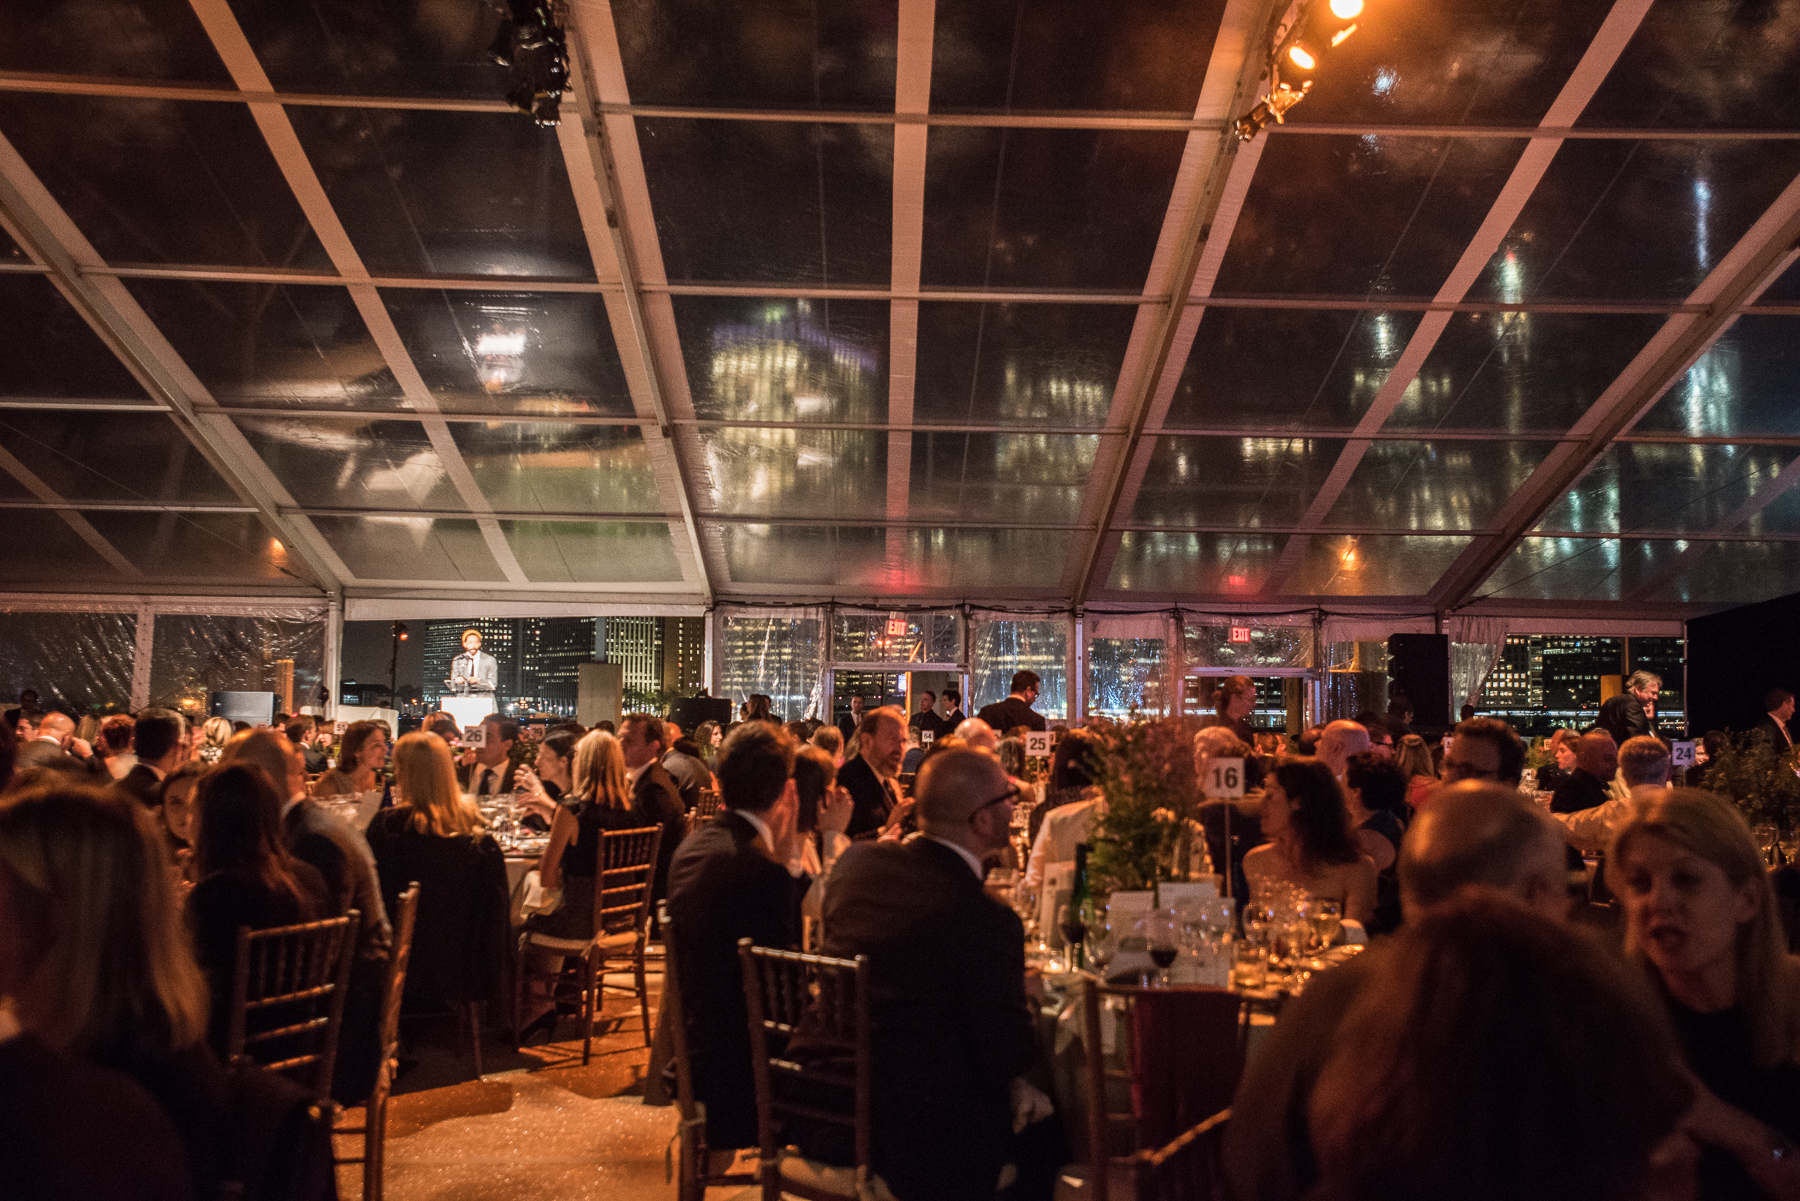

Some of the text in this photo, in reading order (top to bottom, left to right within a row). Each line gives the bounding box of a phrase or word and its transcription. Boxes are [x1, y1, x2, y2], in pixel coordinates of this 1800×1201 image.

[888, 620, 907, 636] EXIT
[1232, 627, 1250, 642] EXIT
[466, 729, 482, 742] 26
[1030, 738, 1046, 750] 25
[1675, 747, 1692, 760] 24
[1212, 766, 1238, 789] 16
